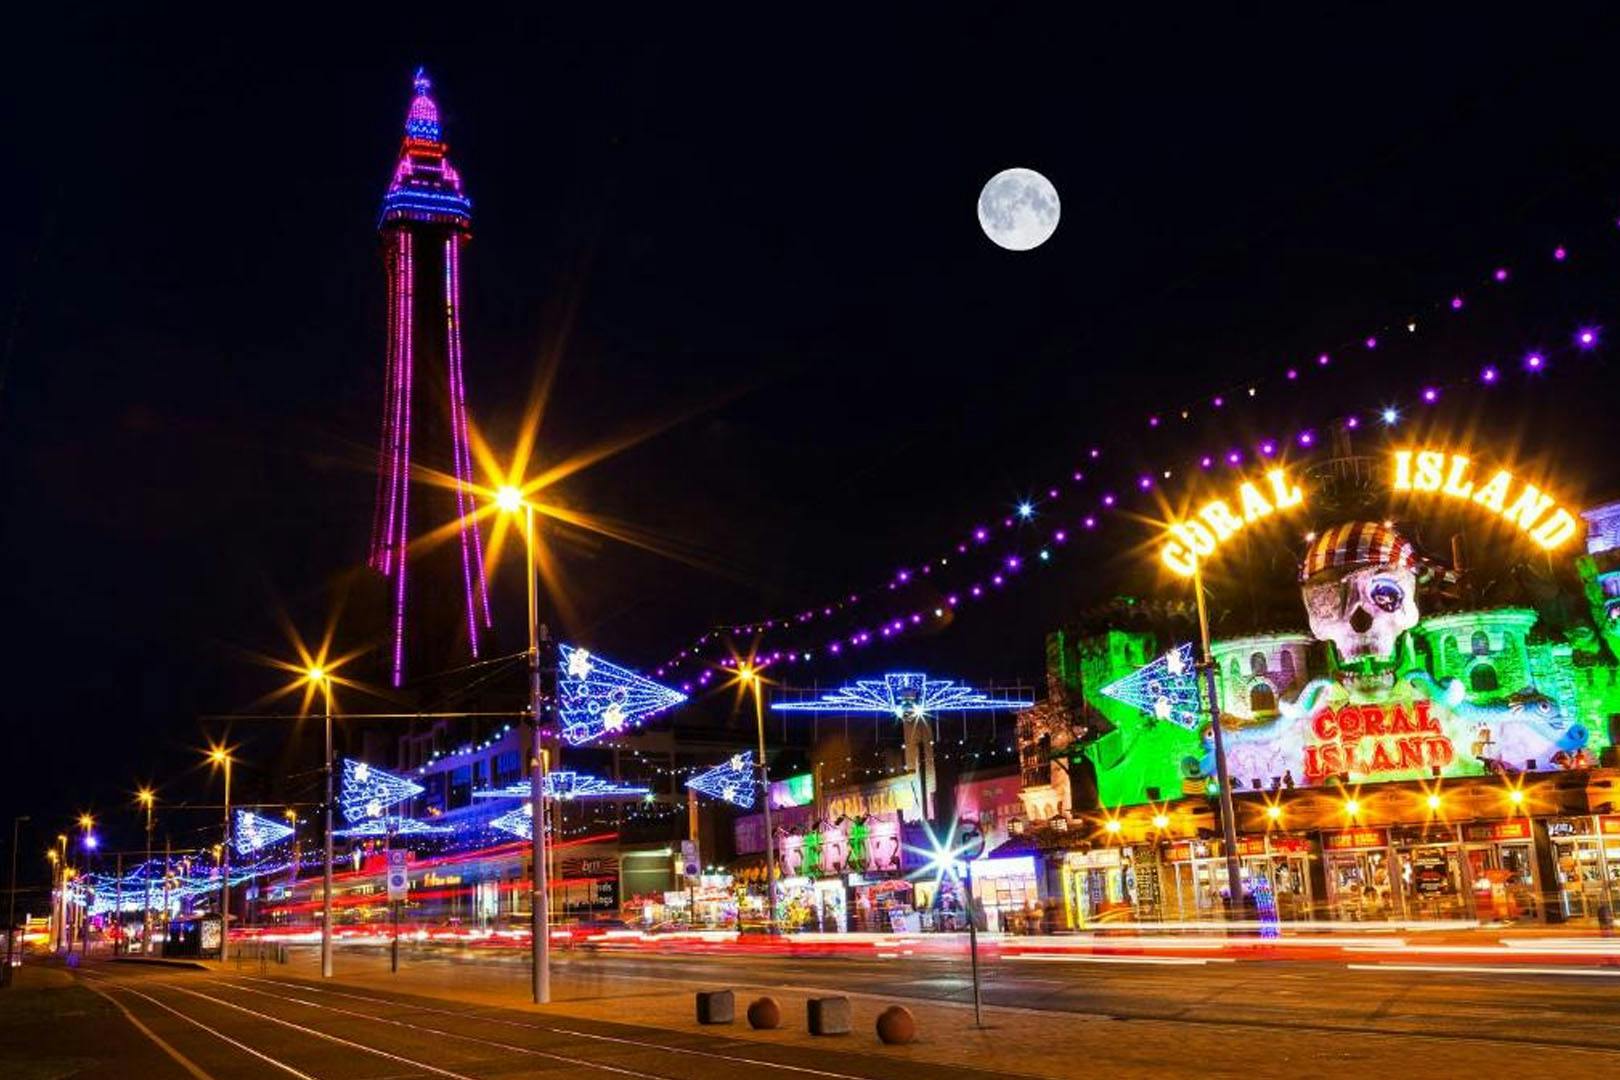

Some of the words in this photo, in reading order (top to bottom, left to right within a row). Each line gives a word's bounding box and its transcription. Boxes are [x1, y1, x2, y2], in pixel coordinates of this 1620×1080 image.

[1161, 468, 1303, 577] CORAL
[1393, 450, 1577, 550] ISLAND
[1311, 700, 1442, 745] CORAL
[1303, 736, 1453, 778] ISLAND
